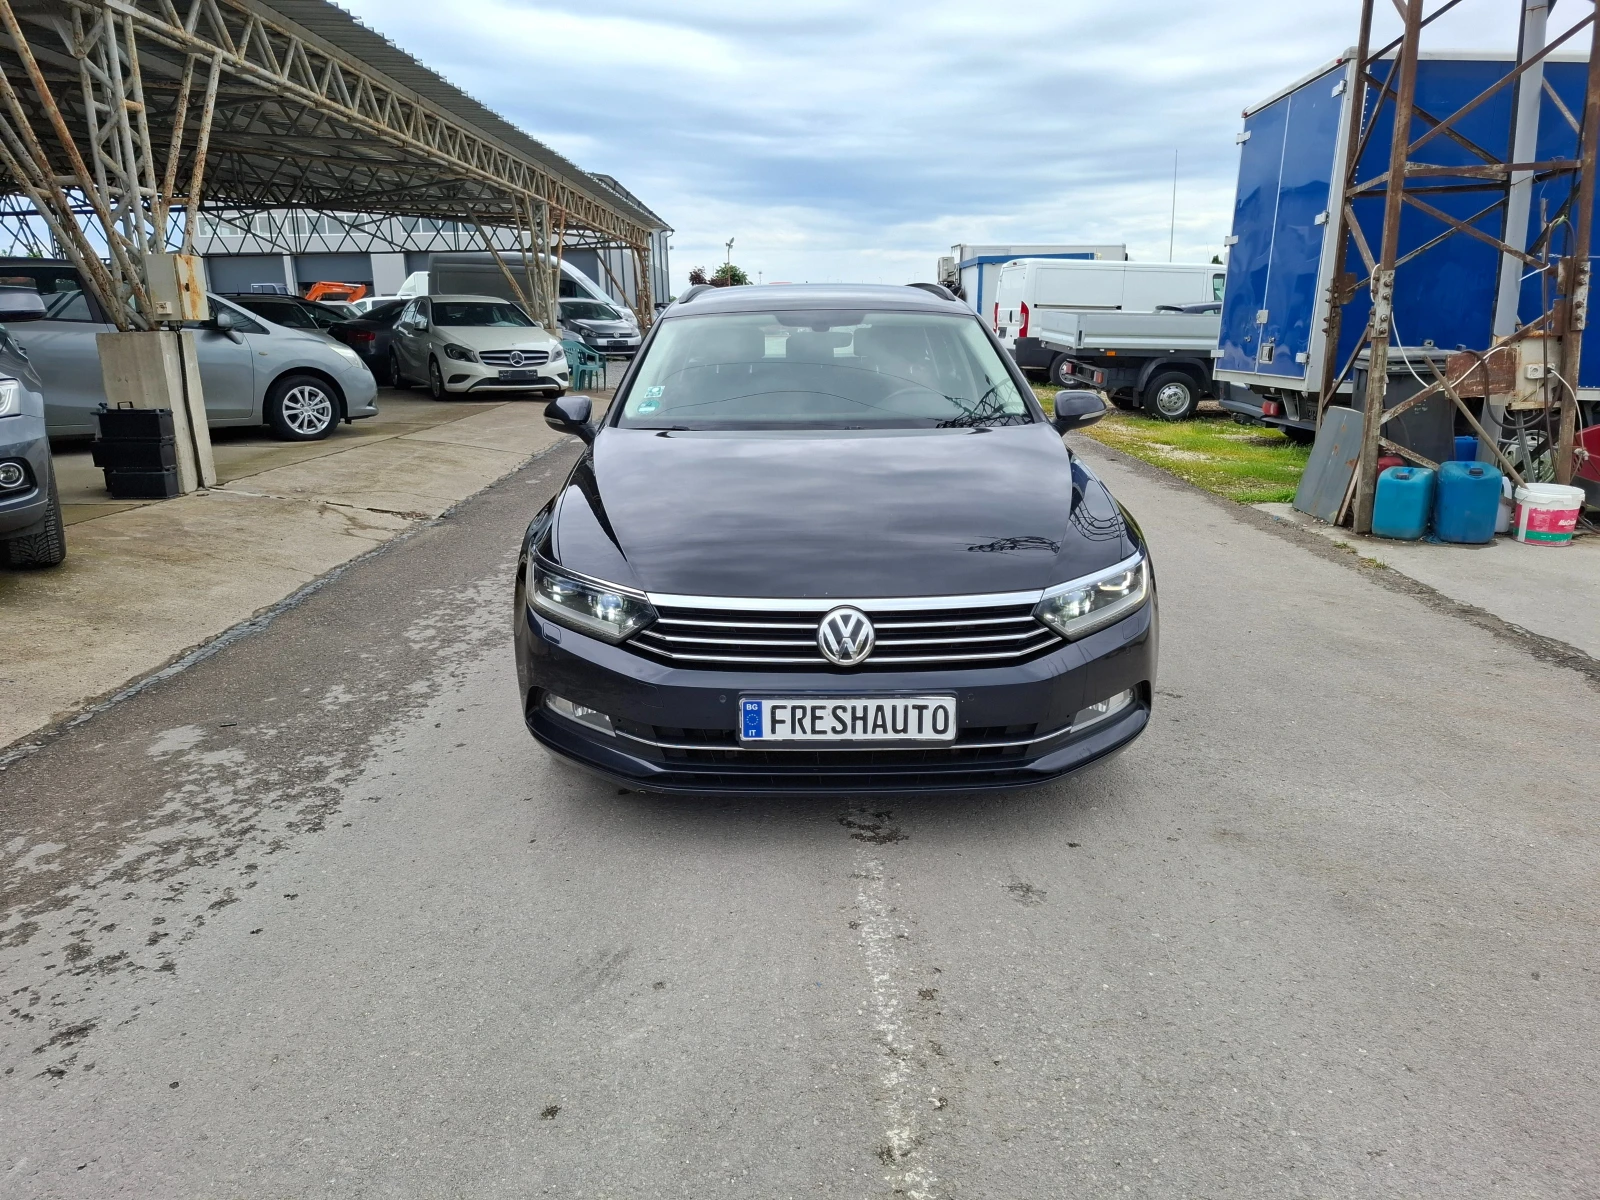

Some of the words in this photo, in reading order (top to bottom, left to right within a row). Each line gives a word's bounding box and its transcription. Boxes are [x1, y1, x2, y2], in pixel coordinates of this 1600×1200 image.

[820, 609, 873, 664] VW
[746, 703, 758, 711] BG
[770, 704, 949, 735] FRESHAUTO
[748, 729, 757, 737] IT
